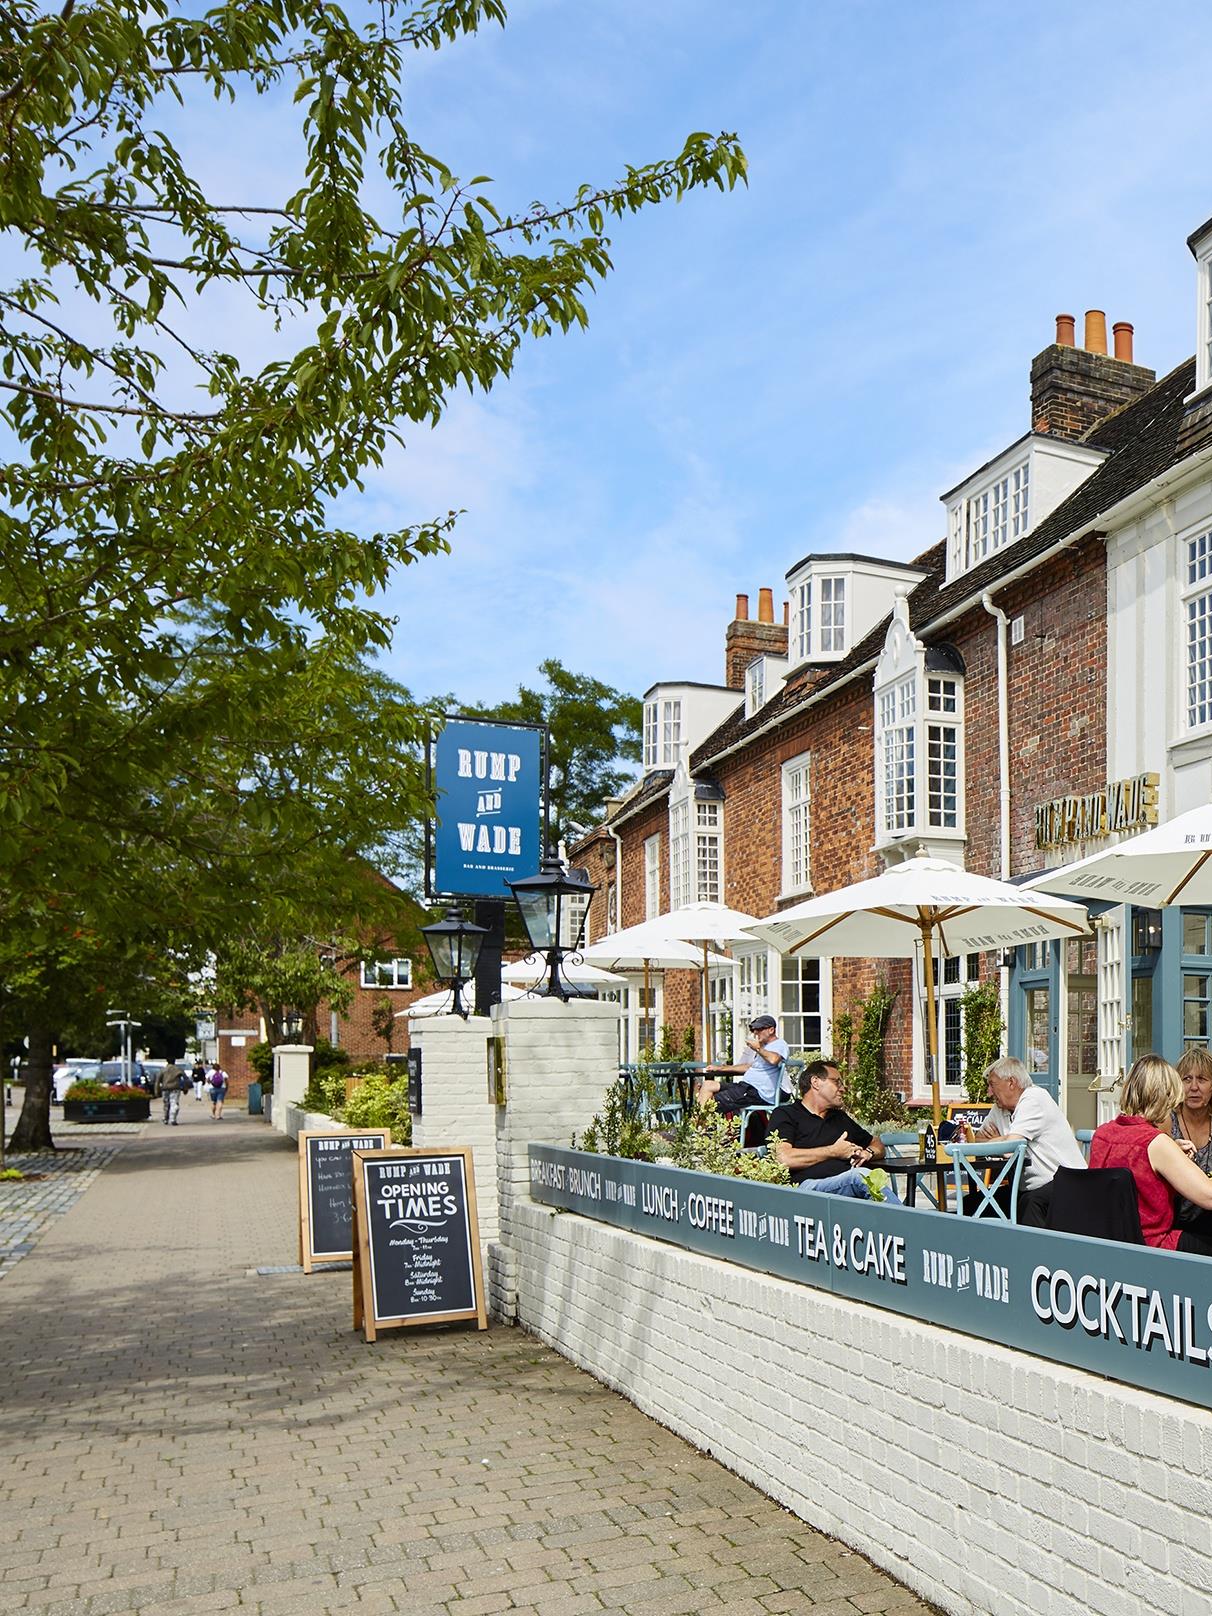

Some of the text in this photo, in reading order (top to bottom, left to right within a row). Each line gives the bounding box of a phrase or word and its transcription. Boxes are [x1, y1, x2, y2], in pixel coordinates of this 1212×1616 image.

[457, 749, 521, 782] RUMP
[477, 793, 502, 812] AND
[457, 823, 521, 855] WADE
[318, 1140, 340, 1151] RUMP
[352, 1139, 374, 1149] WADE
[379, 1166, 406, 1178] RUMP
[423, 1162, 451, 1175] WADE
[381, 1181, 449, 1198] OPENING
[569, 1167, 602, 1201] BRUNCH
[377, 1195, 457, 1219] TIMES
[642, 1182, 735, 1238] LUNCH COFFEE
[389, 1238, 416, 1248] Monday
[418, 1236, 449, 1244] Thursday
[794, 1215, 830, 1264] TEA
[850, 1227, 907, 1285] CAKE
[412, 1253, 433, 1262] Friday
[410, 1270, 439, 1280] Saturday
[923, 1249, 1010, 1303] RUMP AND WADE
[413, 1288, 435, 1297] Sunday
